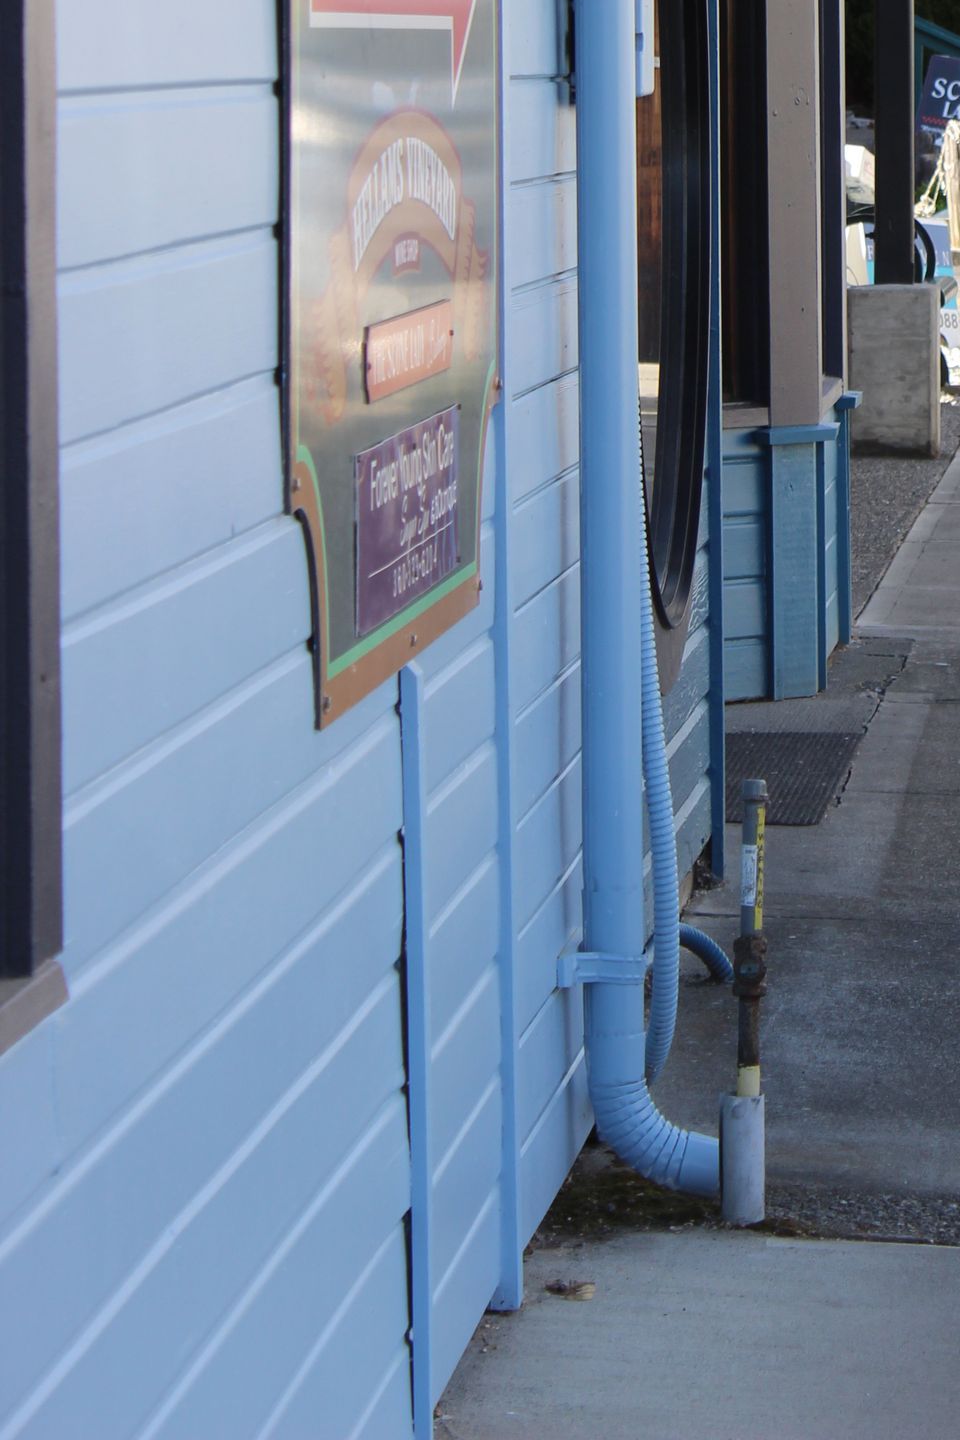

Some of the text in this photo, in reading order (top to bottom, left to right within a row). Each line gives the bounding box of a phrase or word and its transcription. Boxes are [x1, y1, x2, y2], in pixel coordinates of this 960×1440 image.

[352, 136, 456, 273] HELLAMS VINEYARD
[370, 424, 455, 511] Forever Young Skin Care
